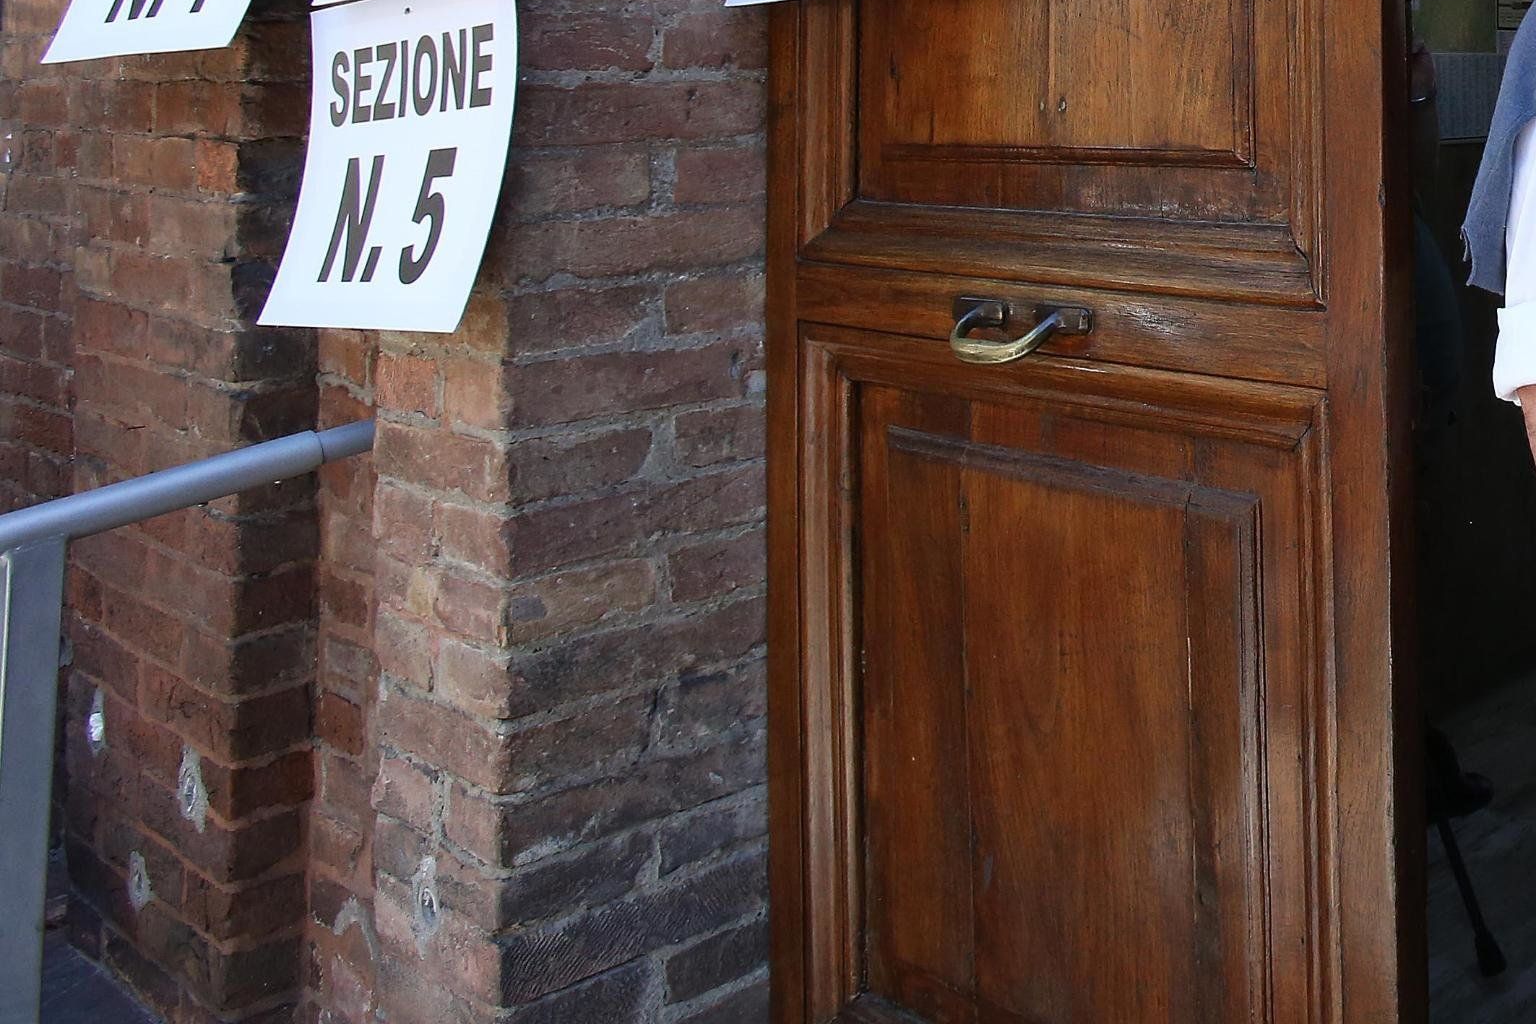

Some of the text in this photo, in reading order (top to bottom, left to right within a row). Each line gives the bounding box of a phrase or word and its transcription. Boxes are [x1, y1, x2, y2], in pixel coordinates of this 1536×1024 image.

[329, 22, 494, 128] SEZIONE
[316, 146, 458, 285] N. 5
